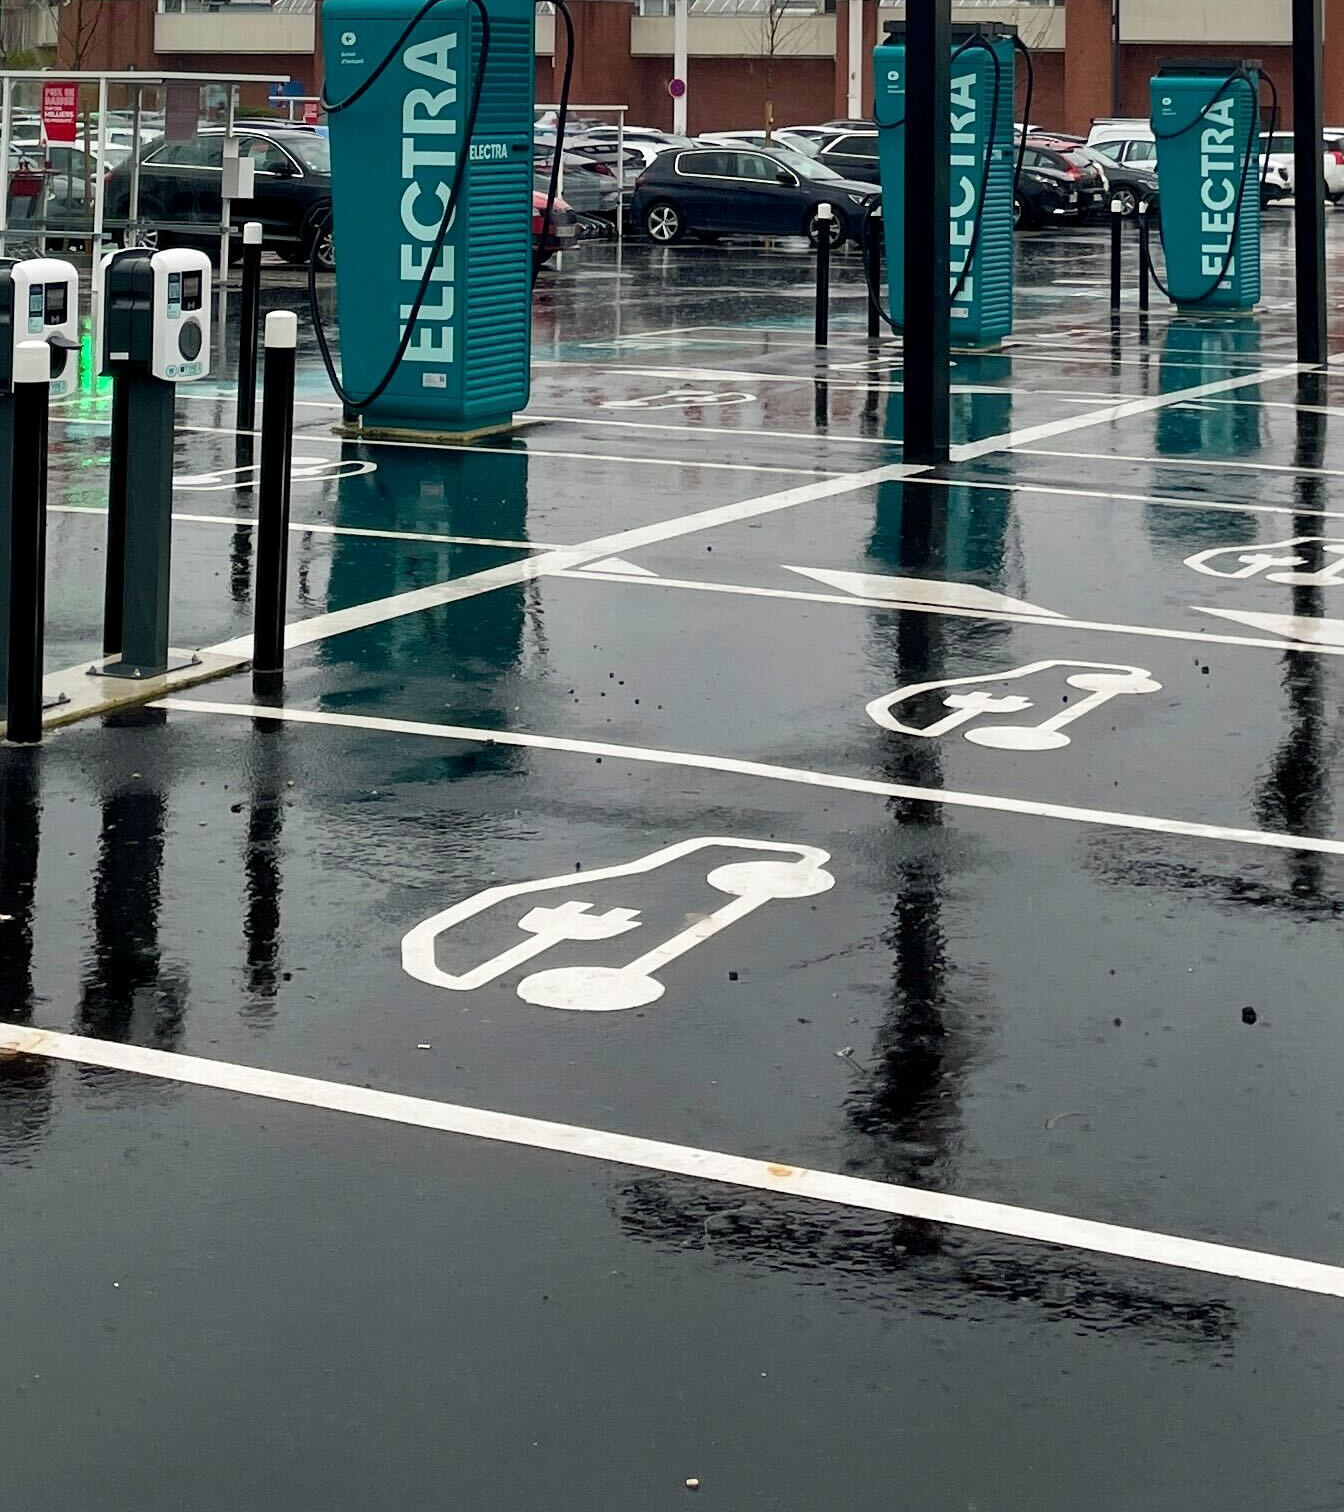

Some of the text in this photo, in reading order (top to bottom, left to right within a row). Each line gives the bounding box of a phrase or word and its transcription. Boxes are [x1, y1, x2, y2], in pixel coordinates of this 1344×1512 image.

[399, 32, 457, 364] ELECTRA
[469, 143, 508, 160] ELECTRA
[1201, 98, 1236, 276] ELECTRA
